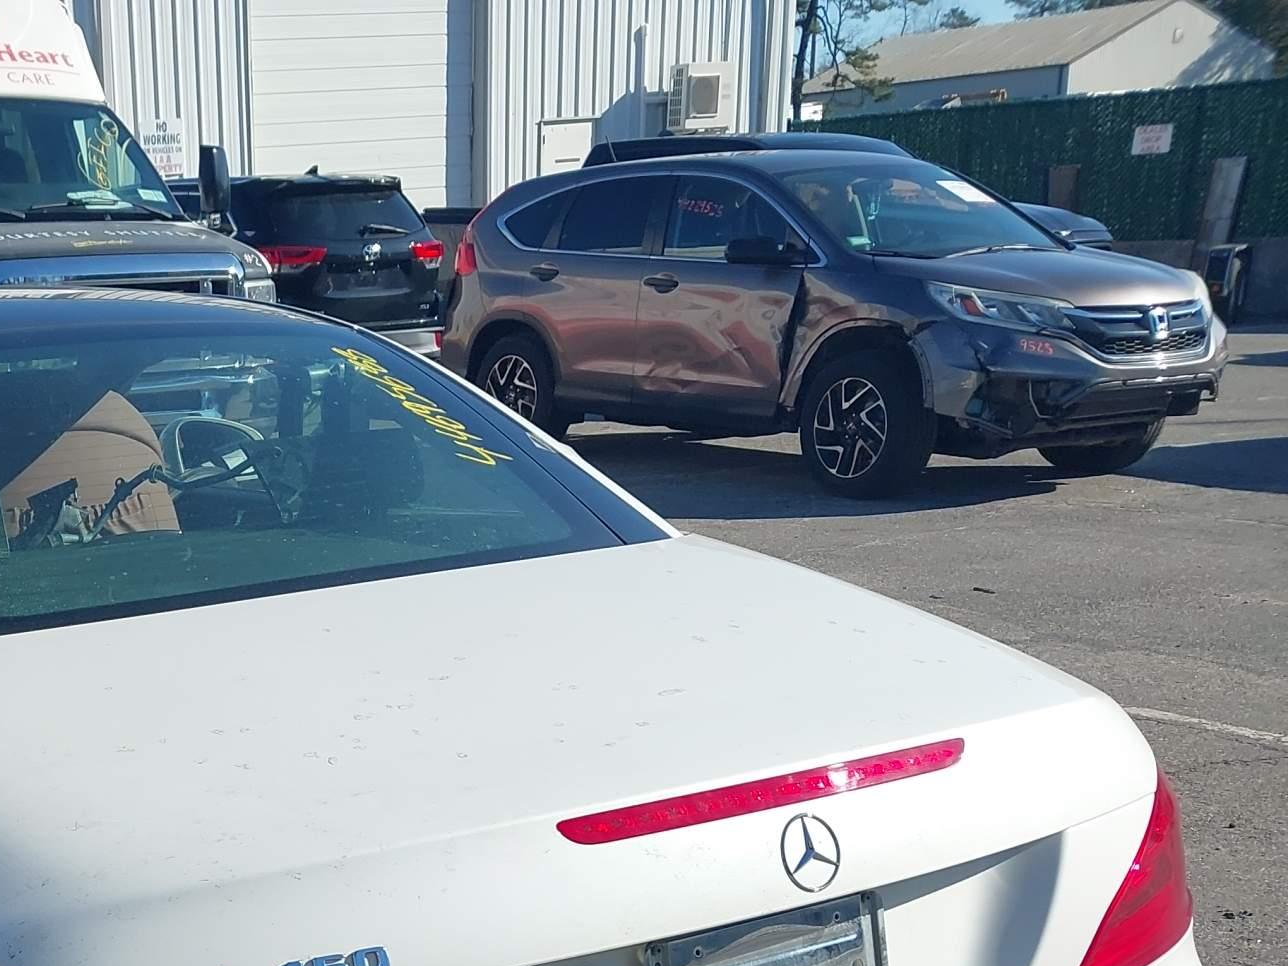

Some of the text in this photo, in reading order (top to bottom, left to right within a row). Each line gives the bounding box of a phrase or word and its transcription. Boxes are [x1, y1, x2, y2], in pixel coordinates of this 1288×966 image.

[7, 71, 55, 85] CARE
[155, 121, 168, 133] NO
[143, 133, 181, 146] WORKING
